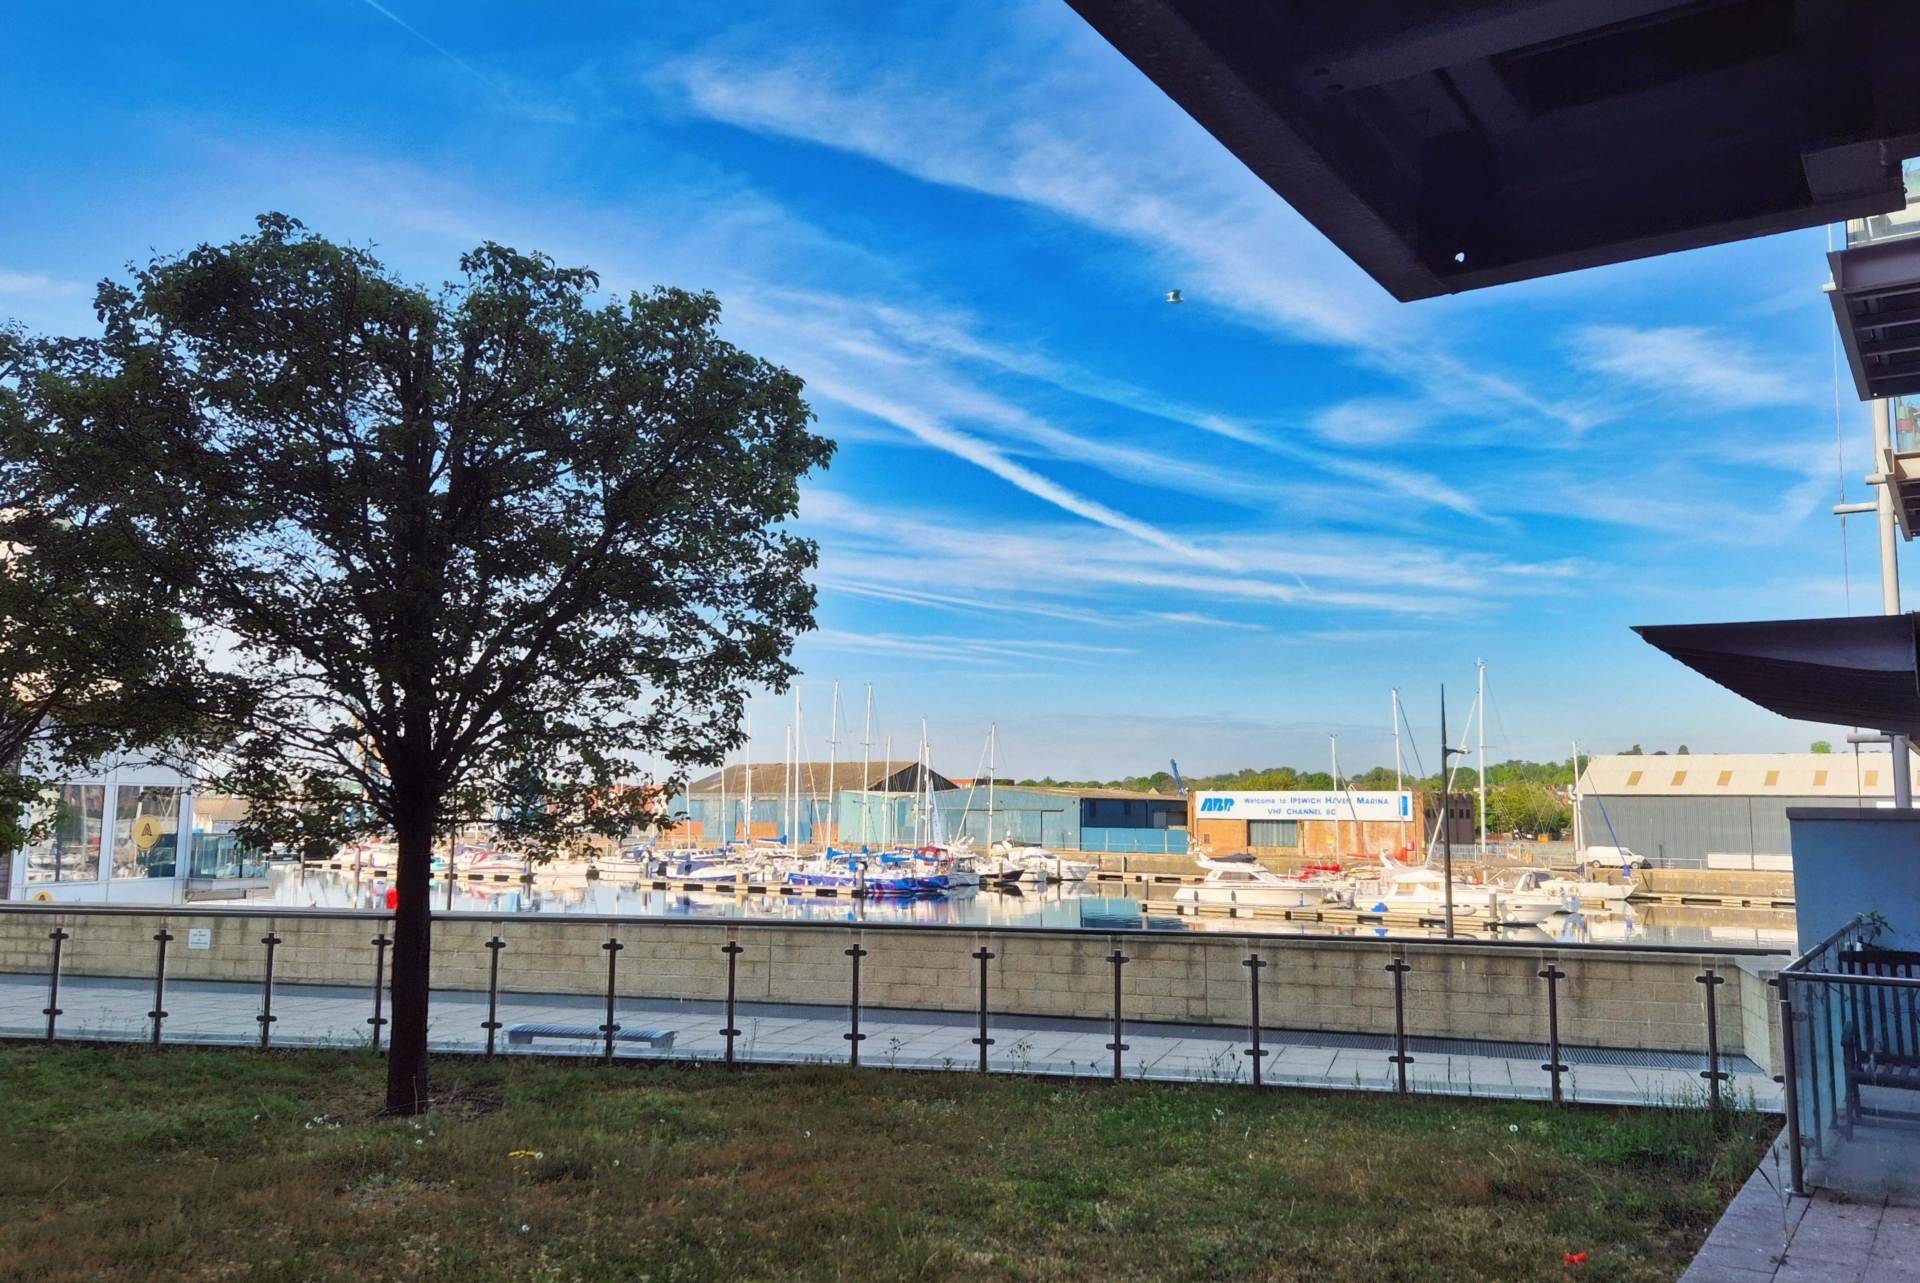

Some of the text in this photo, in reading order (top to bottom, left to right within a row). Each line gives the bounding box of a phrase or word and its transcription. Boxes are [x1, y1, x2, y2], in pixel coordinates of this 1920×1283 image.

[1200, 798, 1235, 812] ABP
[1290, 796, 1321, 804] IPSWICH
[1357, 796, 1389, 804] MARINA
